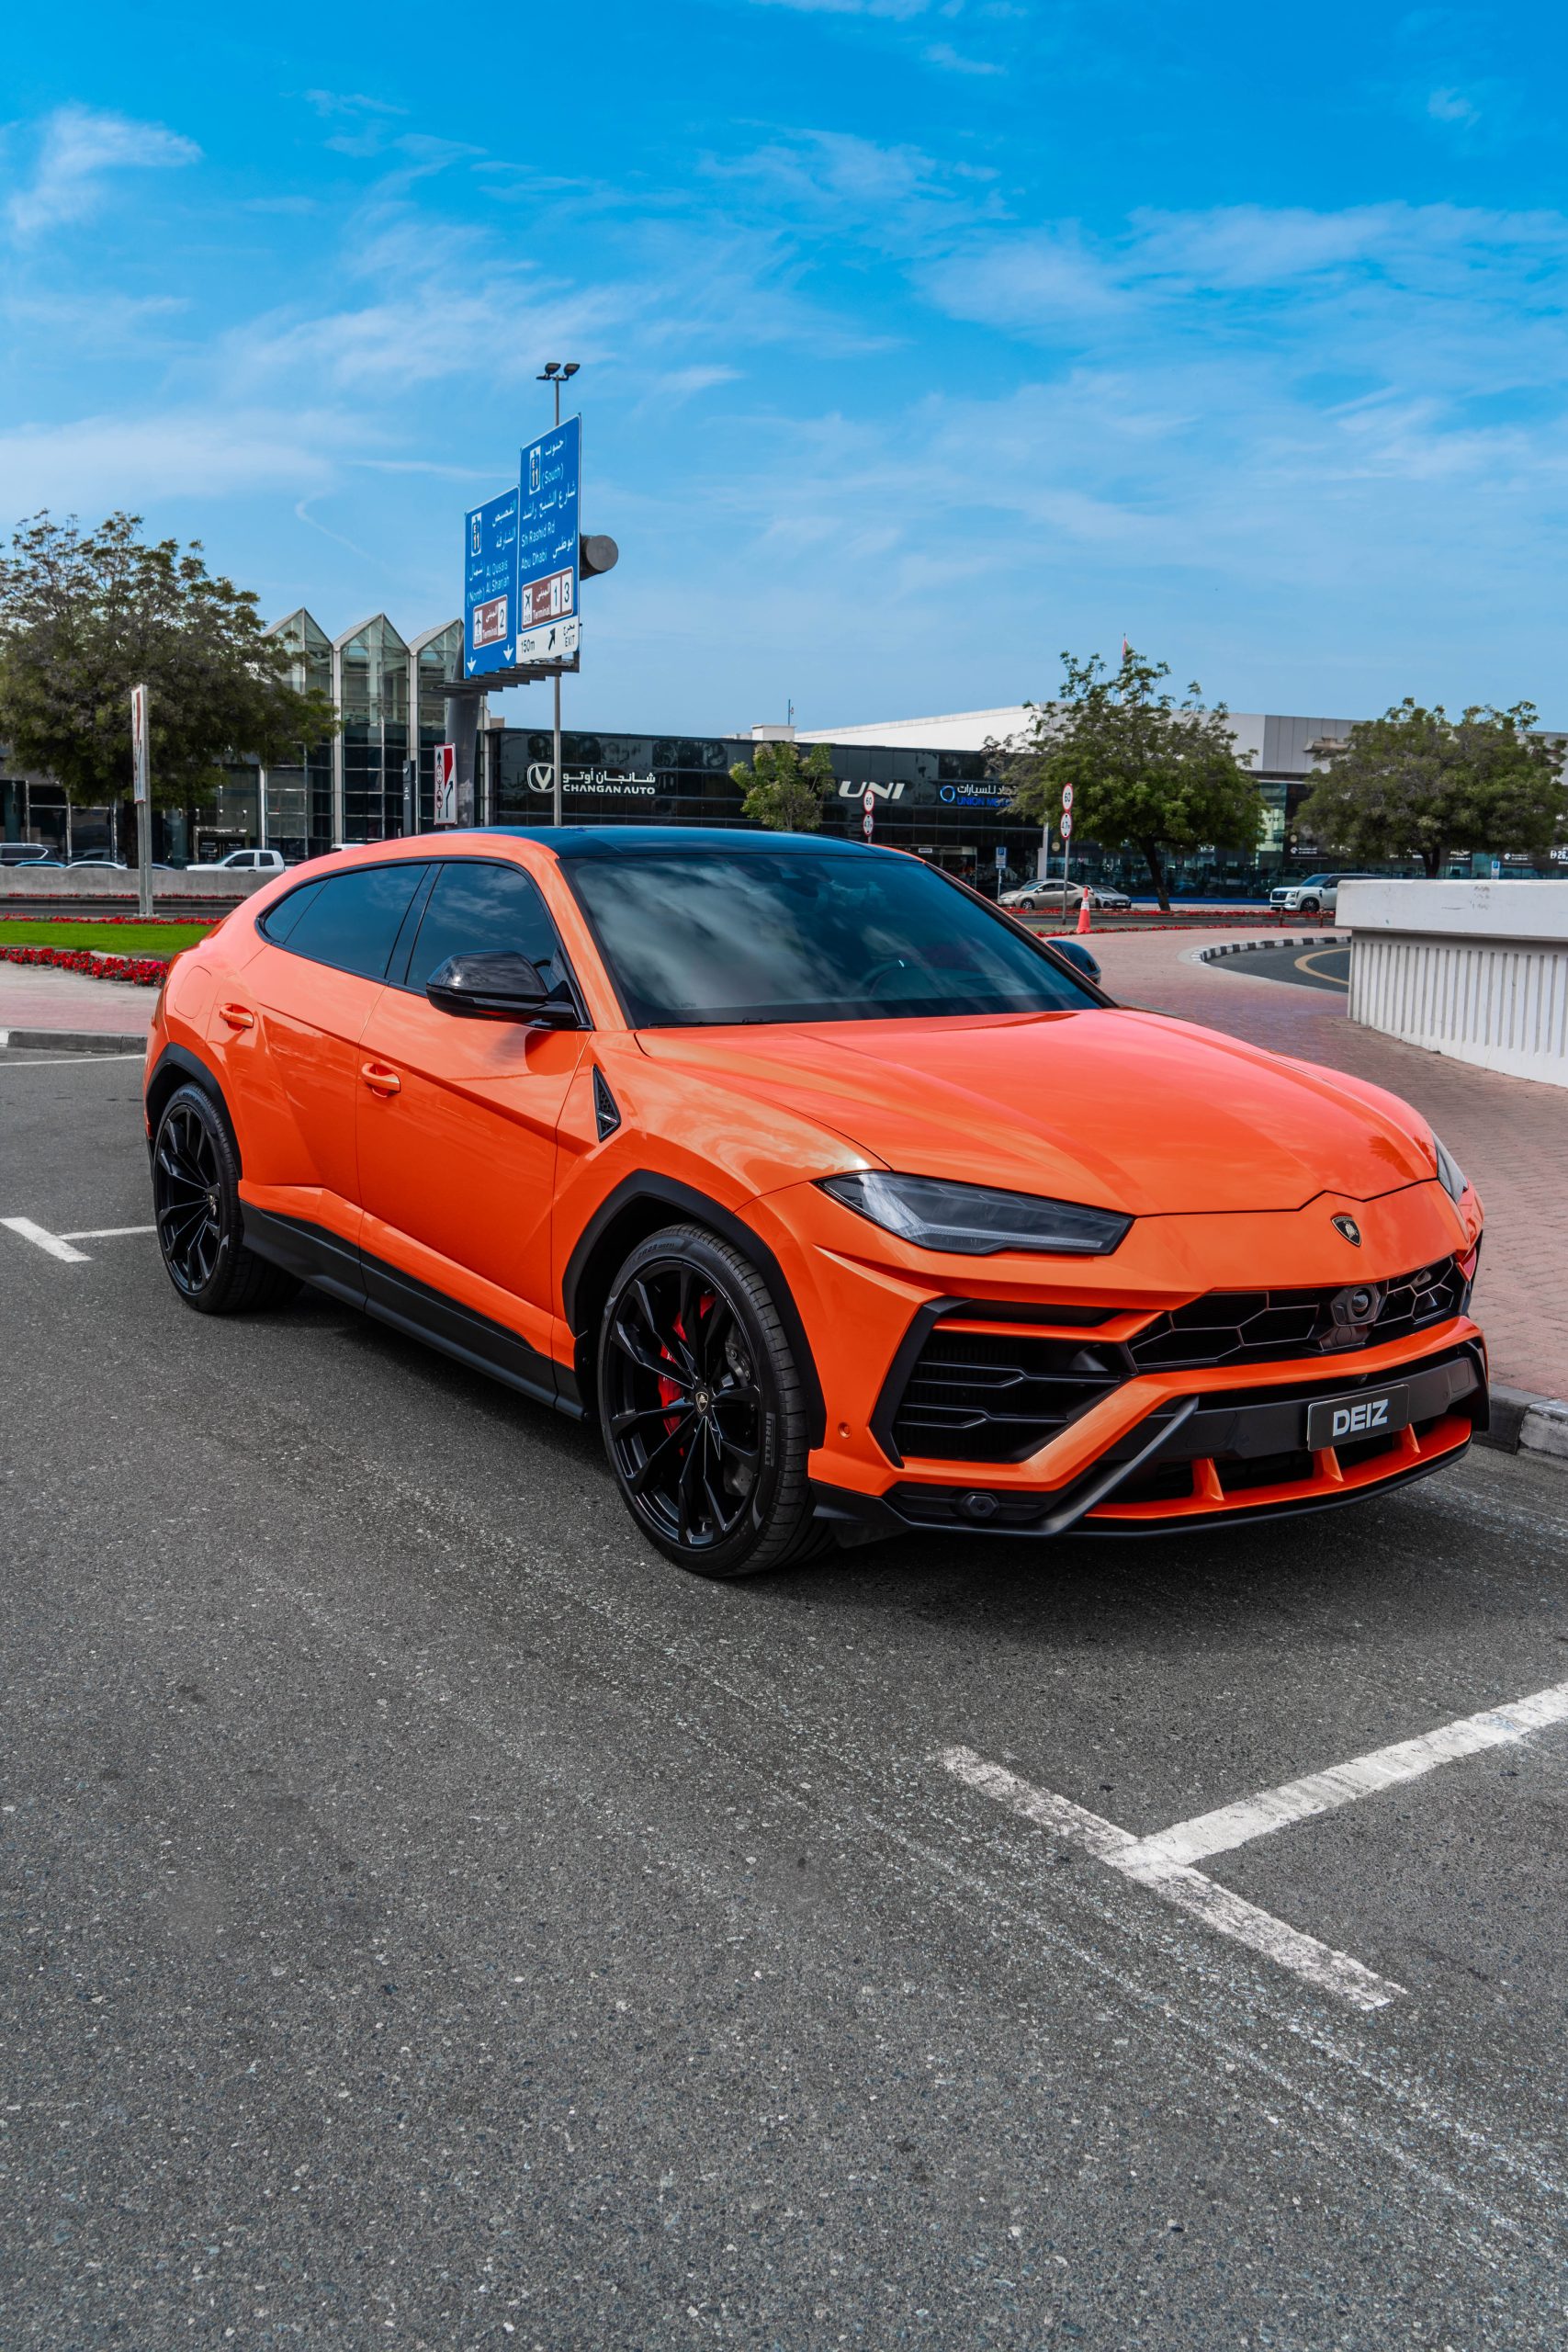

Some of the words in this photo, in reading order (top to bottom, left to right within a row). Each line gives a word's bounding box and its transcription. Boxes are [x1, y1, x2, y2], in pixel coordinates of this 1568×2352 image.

[541, 462, 564, 490] (South)
[558, 480, 576, 509] شارع
[521, 555, 531, 570] Abu
[532, 548, 547, 566] Dhabi
[554, 585, 558, 607] 1
[564, 582, 570, 603] 3
[500, 608, 504, 628] 2
[533, 605, 550, 620] Terminal
[521, 639, 536, 654] 150m
[564, 634, 575, 647] EXIT
[562, 767, 594, 785] أوتو
[596, 770, 656, 785] شانجان
[562, 784, 622, 794] CHANGAN
[623, 786, 656, 795] AUTO
[838, 780, 906, 800] UNI
[1064, 792, 1071, 803] 60
[865, 797, 874, 806] 60
[956, 797, 985, 807] UNION
[1333, 1398, 1389, 1437] DEIZ
[764, 1412, 775, 1467] PIRELLI
